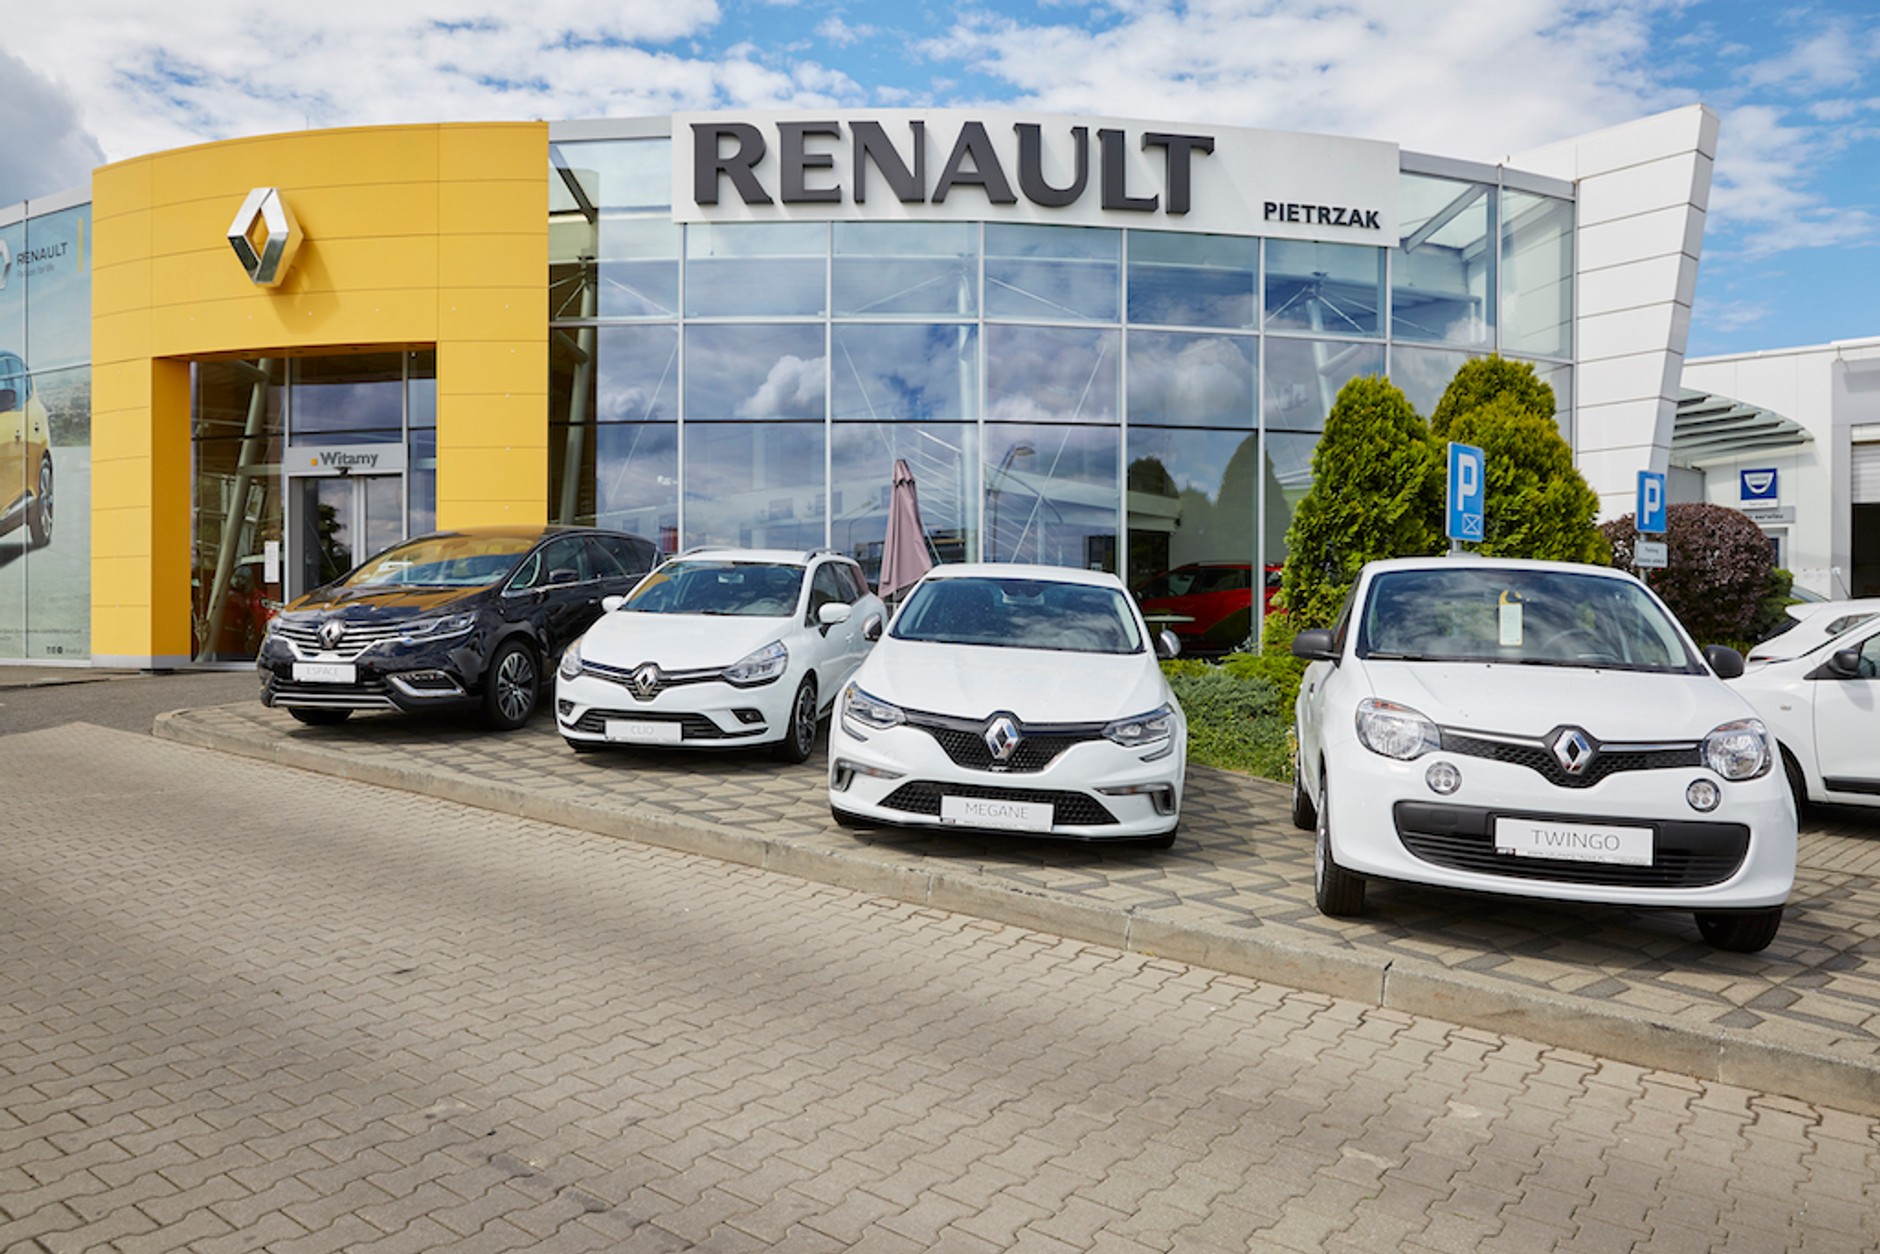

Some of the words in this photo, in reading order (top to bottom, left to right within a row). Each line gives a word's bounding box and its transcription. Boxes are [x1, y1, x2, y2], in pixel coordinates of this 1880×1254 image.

[690, 120, 1215, 216] RENAULT
[1263, 201, 1381, 230] PIETRZAK
[16, 242, 68, 266] RENAULT
[320, 451, 379, 468] Witamy
[1457, 452, 1479, 511] P
[1643, 478, 1661, 525] P
[965, 802, 1029, 820] MEGANE
[1531, 828, 1620, 852] TWINGO
